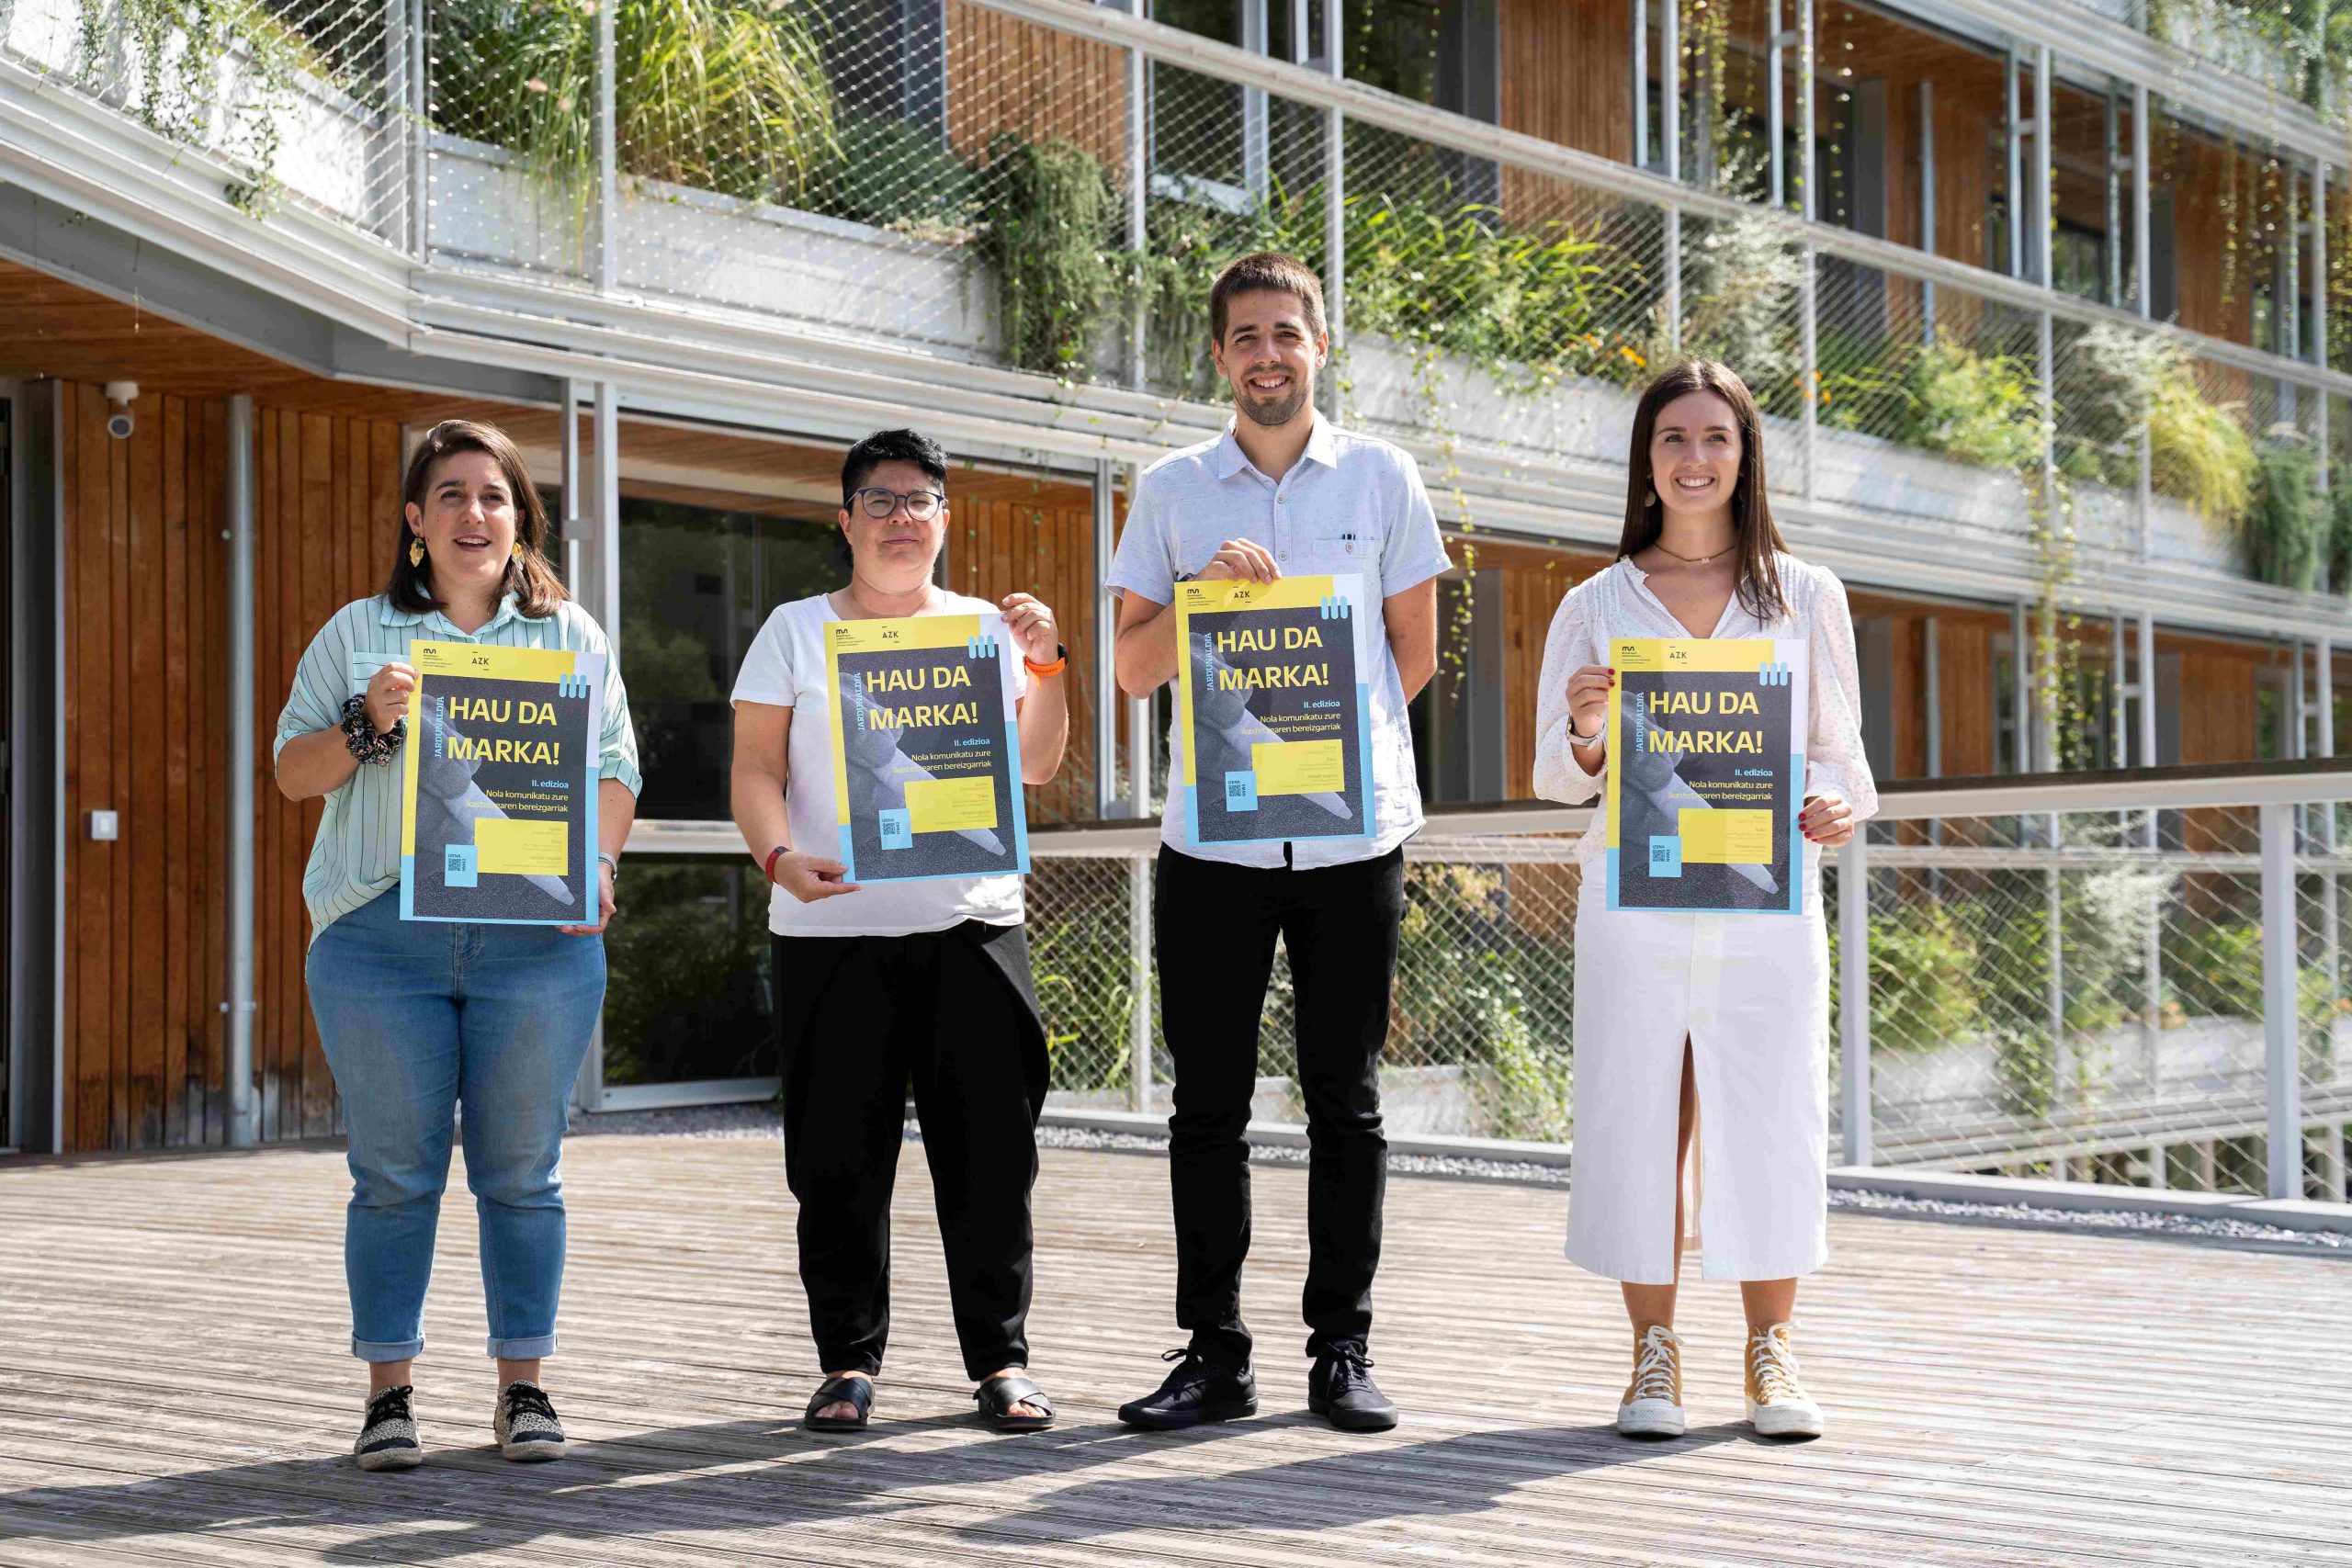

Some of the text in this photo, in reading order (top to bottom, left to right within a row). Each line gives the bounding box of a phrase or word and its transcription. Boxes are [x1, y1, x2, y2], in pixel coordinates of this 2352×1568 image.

[1233, 591, 1250, 599] AZK
[1217, 626, 1324, 653] HAU DA
[471, 657, 490, 665] AZK
[1204, 632, 1215, 692] JARDUNALDIA
[866, 665, 972, 693] HAU DA
[1218, 662, 1329, 691] MARKA!
[854, 672, 865, 731] JARDUNALDIA
[1303, 699, 1340, 709] II. edizioa
[1649, 691, 1759, 715] HAU DA
[449, 696, 558, 726] HAU DA
[869, 702, 978, 730] MARKA!
[1260, 715, 1278, 723] Nola
[1278, 713, 1323, 722] komunikatu
[1635, 692, 1645, 753] JARDUNALDIA
[435, 695, 445, 759] JARDUNALDIA
[1292, 723, 1341, 732] bereizgarriak
[962, 738, 990, 746] edizioa
[1649, 730, 1763, 754] MARKA!
[447, 737, 560, 766] MARKA!
[911, 753, 929, 761] Nola
[930, 751, 974, 761] komunikatu
[944, 760, 992, 770] bereizgarriak
[1744, 769, 1773, 777] edizioa
[531, 779, 570, 789] II. edizioa
[1708, 781, 1754, 789] komunikatu
[486, 789, 569, 802] Nola komunikatu zure
[1722, 792, 1773, 802] bereizgarriak
[518, 802, 568, 813] bereizgarriak
